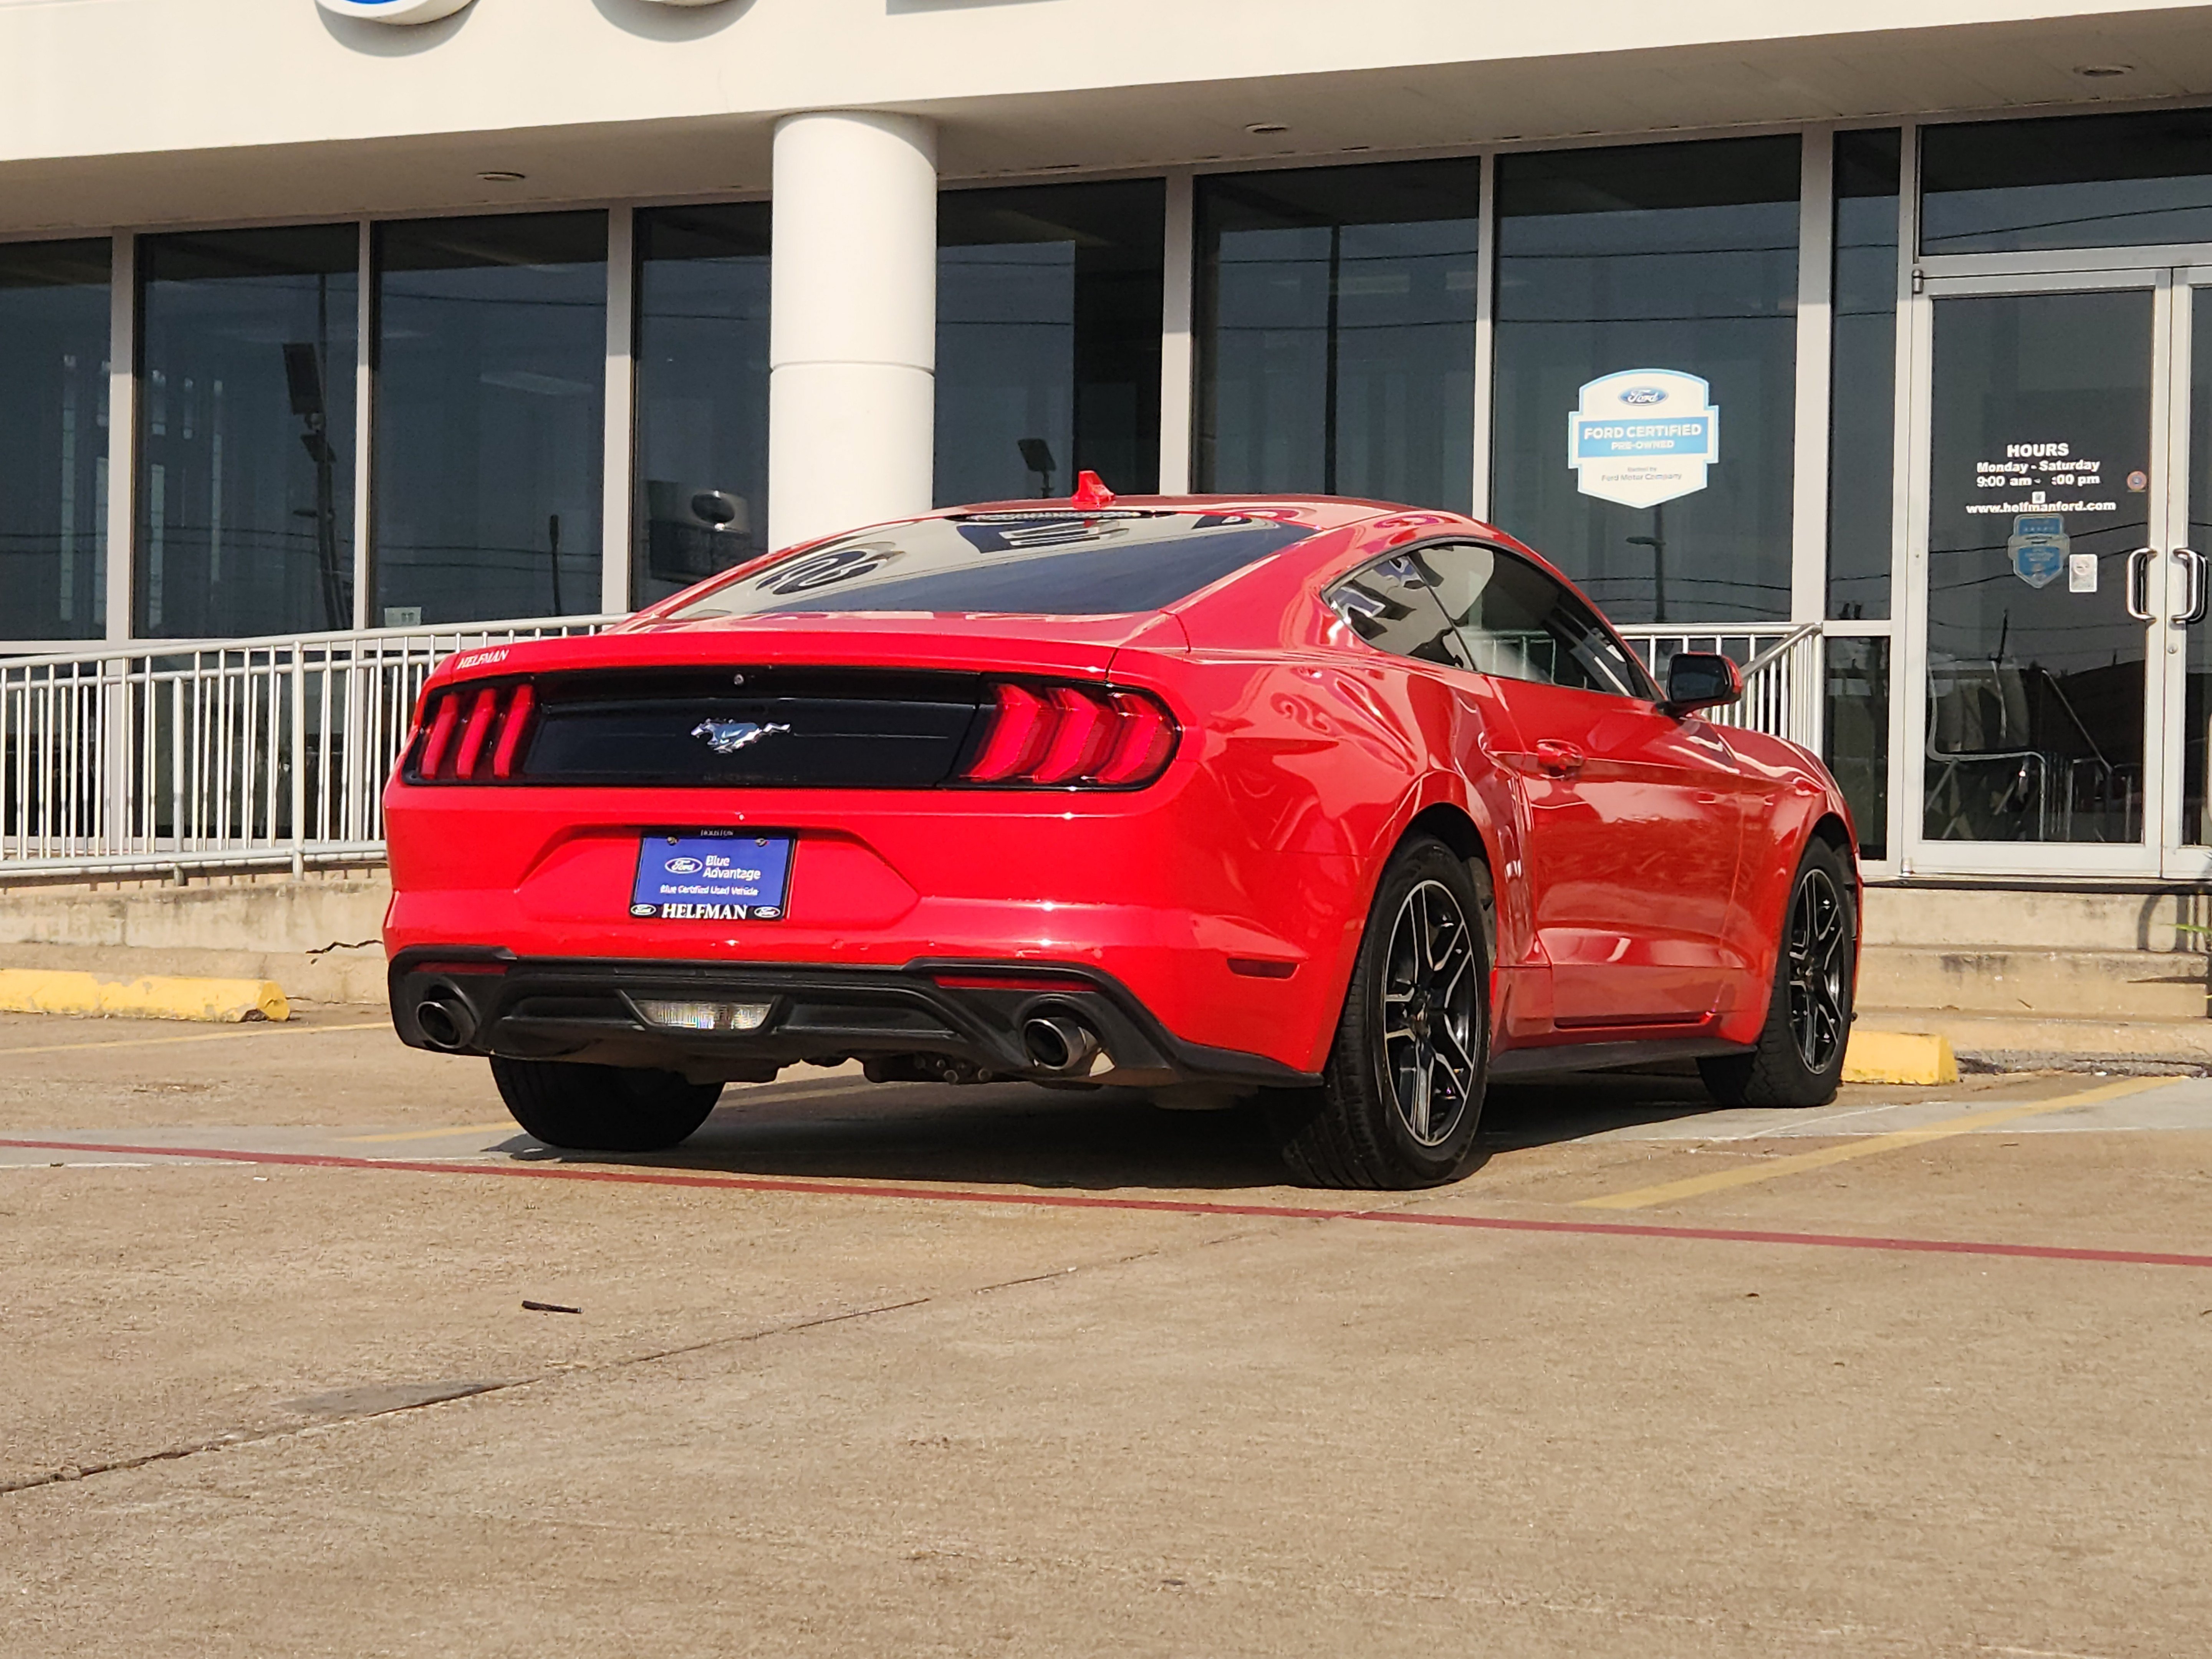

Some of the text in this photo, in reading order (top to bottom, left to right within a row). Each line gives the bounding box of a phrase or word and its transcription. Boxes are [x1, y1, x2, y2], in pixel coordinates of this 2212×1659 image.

[1628, 389, 1659, 402] Ford
[1584, 424, 1702, 440] FORD CERTIFIED
[1611, 440, 1675, 450] PRE-OWNED
[2007, 443, 2069, 457] HOURS
[1977, 462, 2029, 474] Monday
[2039, 459, 2100, 472] Saturday
[1977, 476, 2005, 488] 9:00
[2010, 477, 2032, 486] am
[2078, 475, 2100, 487] pm
[457, 649, 510, 670] HELFMAN
[671, 860, 695, 871] Ford
[705, 855, 730, 866] Blue
[702, 867, 761, 881] Advantage
[661, 903, 748, 919] HELFMAN
